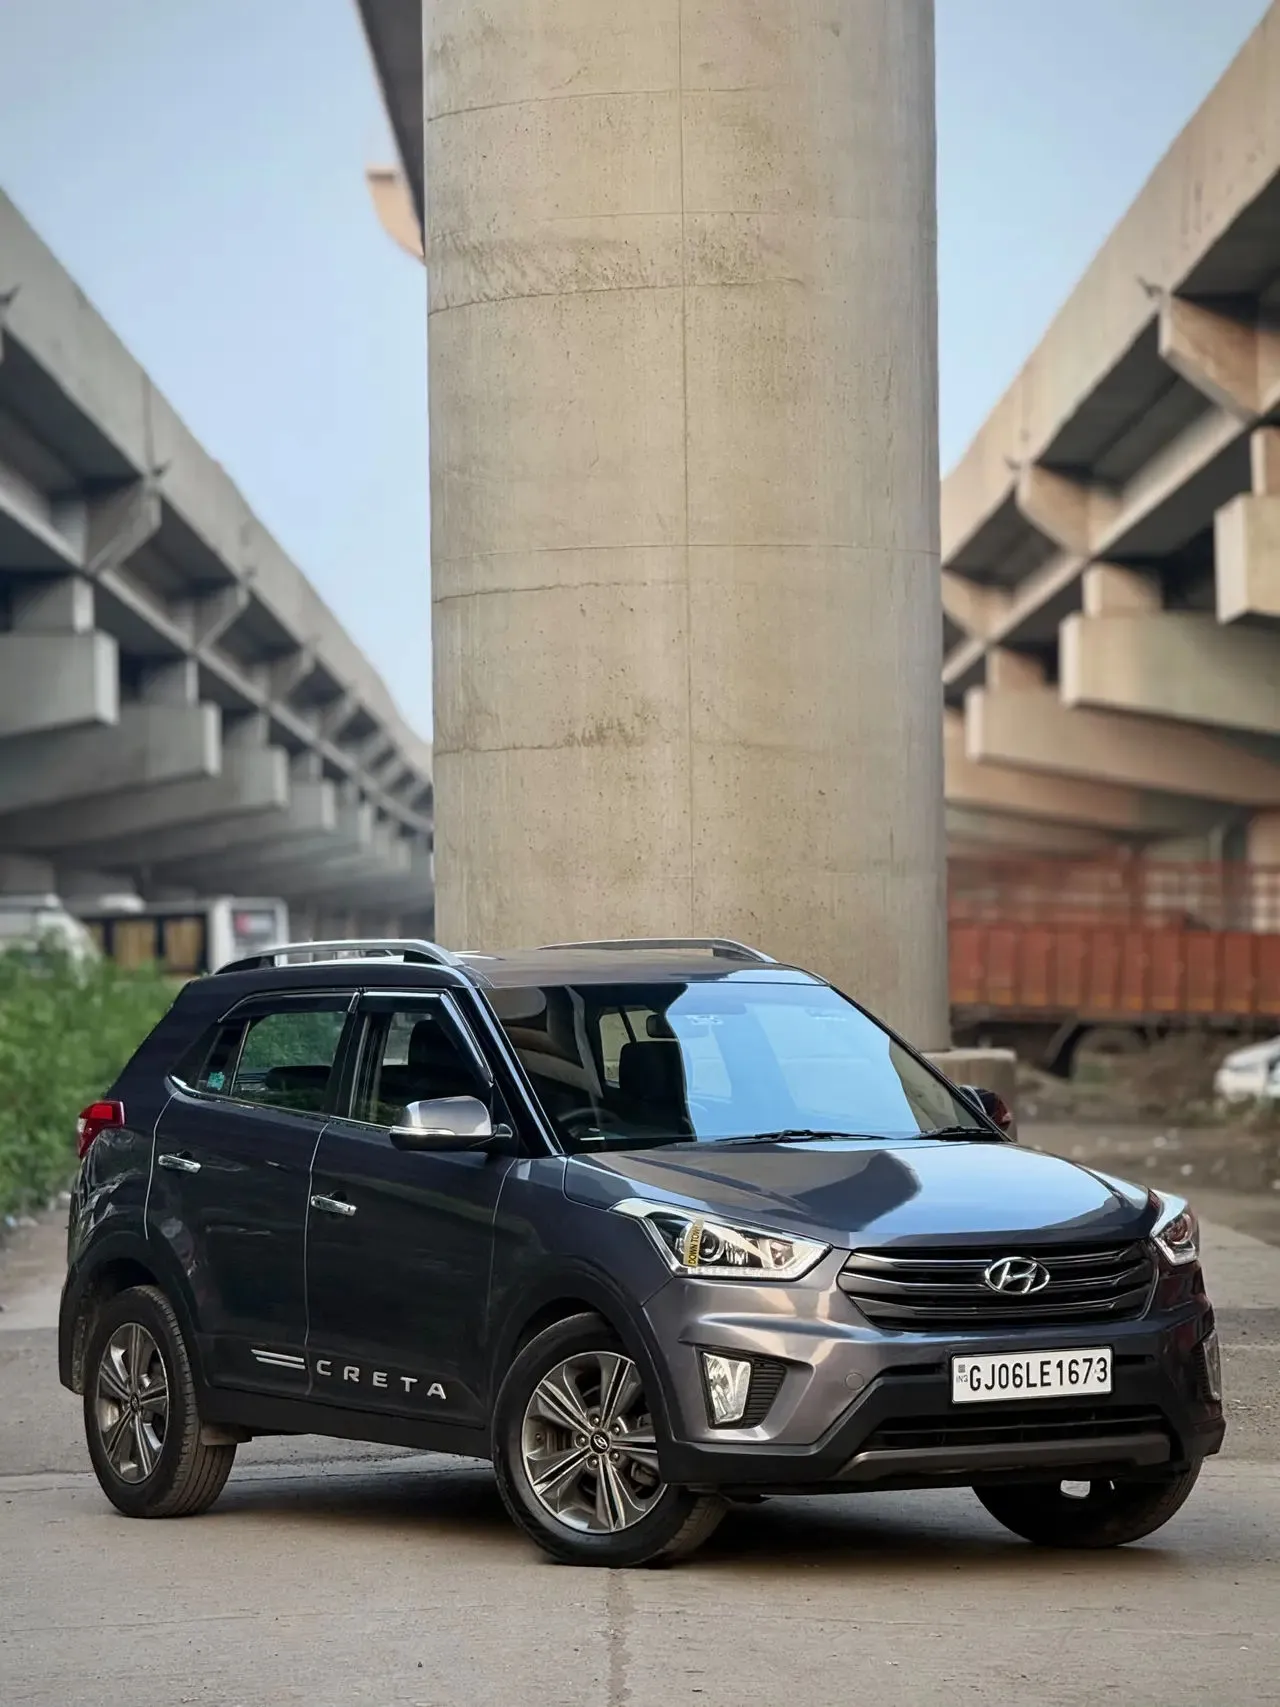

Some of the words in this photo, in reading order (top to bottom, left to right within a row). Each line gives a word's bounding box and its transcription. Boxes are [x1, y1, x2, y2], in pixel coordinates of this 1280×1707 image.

[688, 1243, 699, 1265] DOWN
[316, 1359, 447, 1400] CRETA
[969, 1357, 1108, 1391] GJ06LE1673
